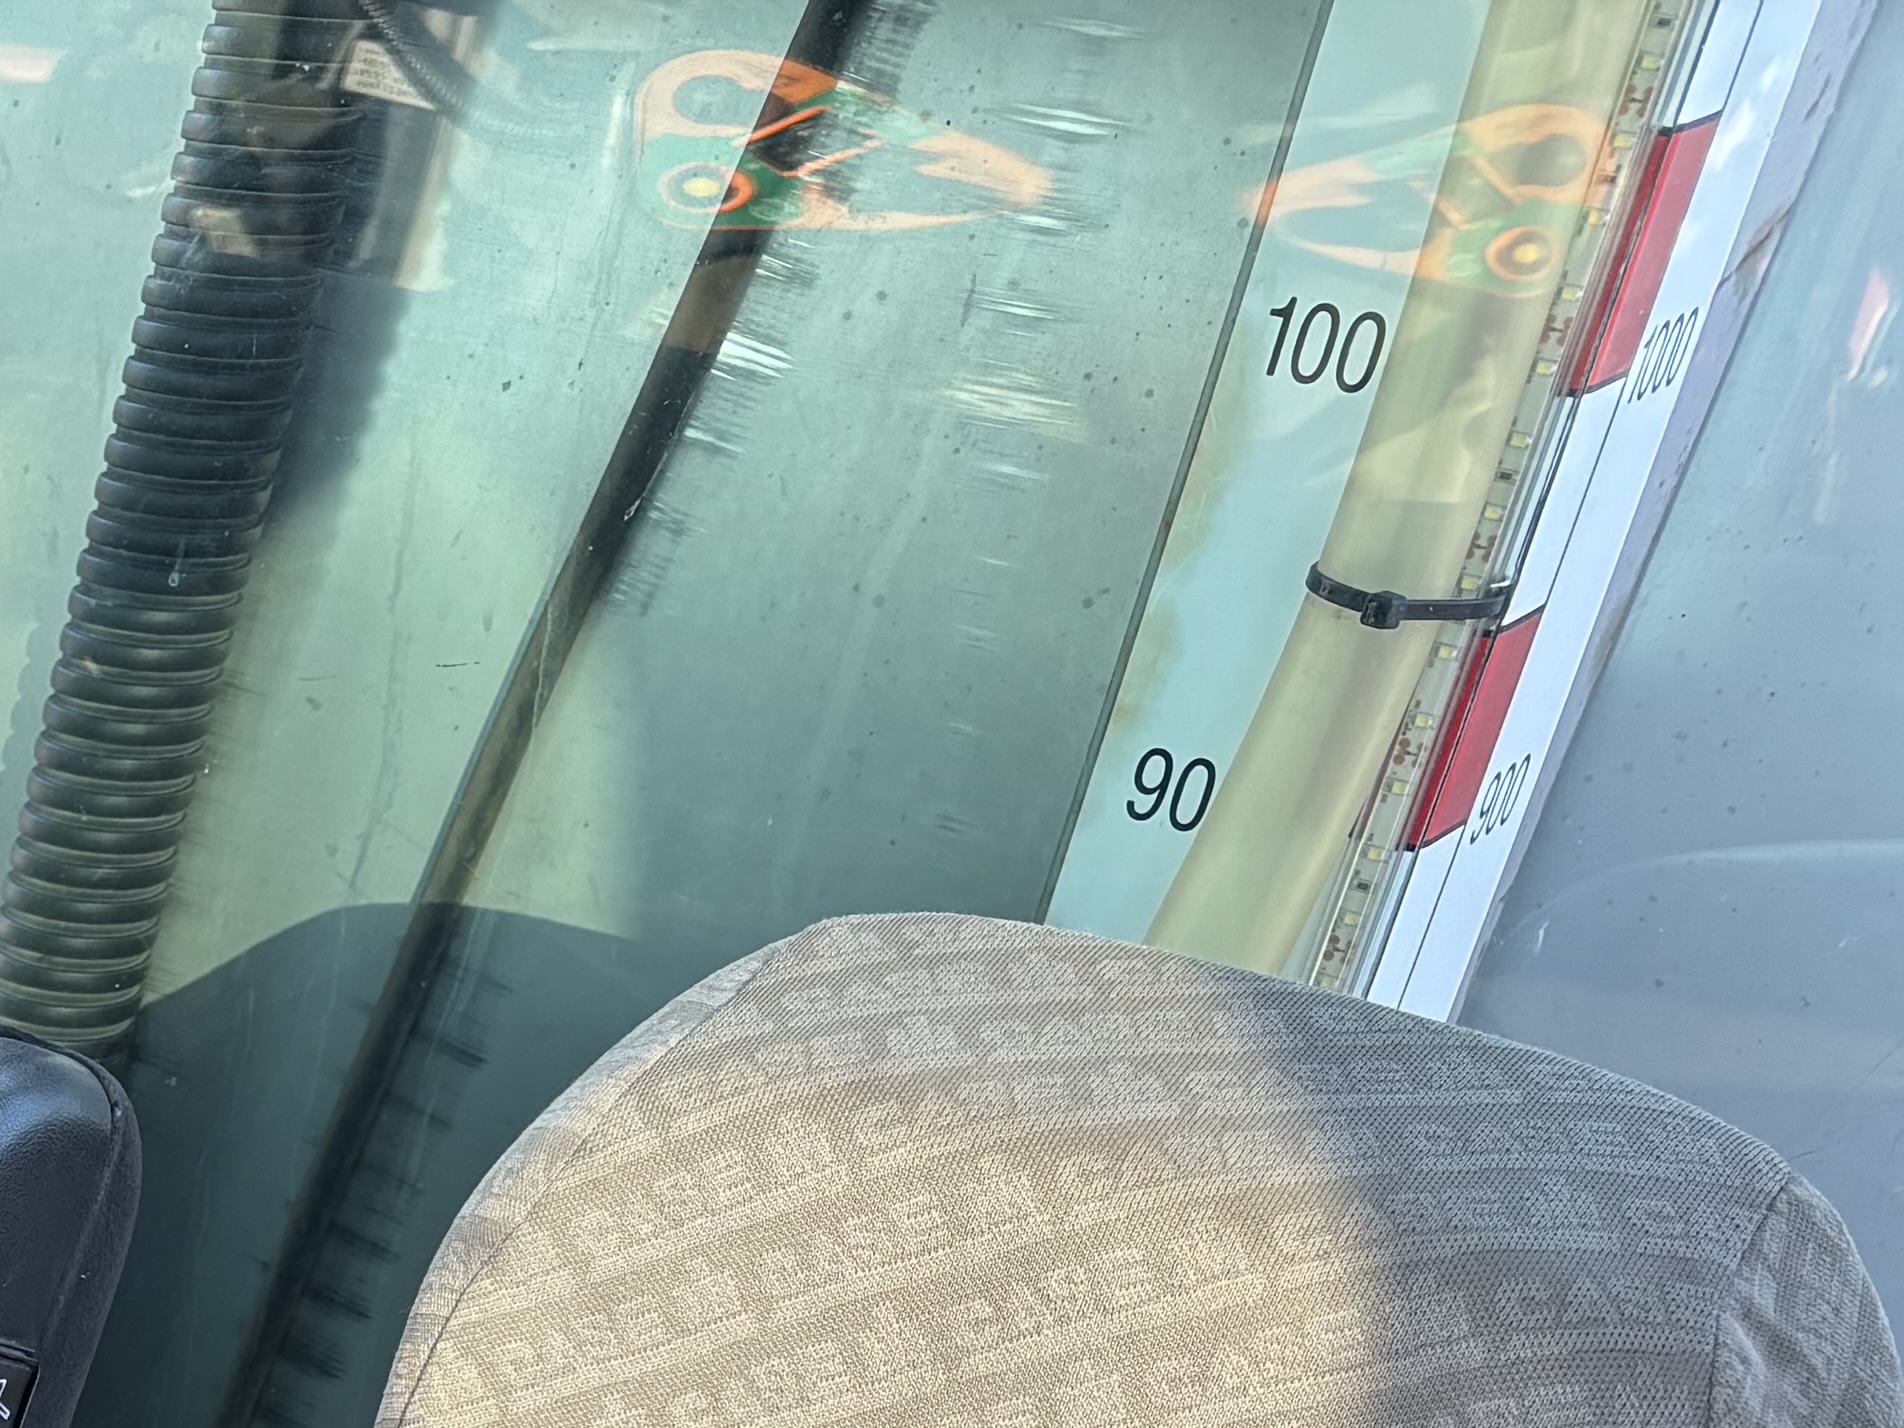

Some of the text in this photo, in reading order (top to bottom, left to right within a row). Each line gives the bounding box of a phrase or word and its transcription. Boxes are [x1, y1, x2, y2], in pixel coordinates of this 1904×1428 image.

[1265, 296, 1387, 393] 100
[1627, 307, 1700, 405] 1000
[1126, 748, 1217, 831] 90
[1469, 753, 1533, 845] 900
